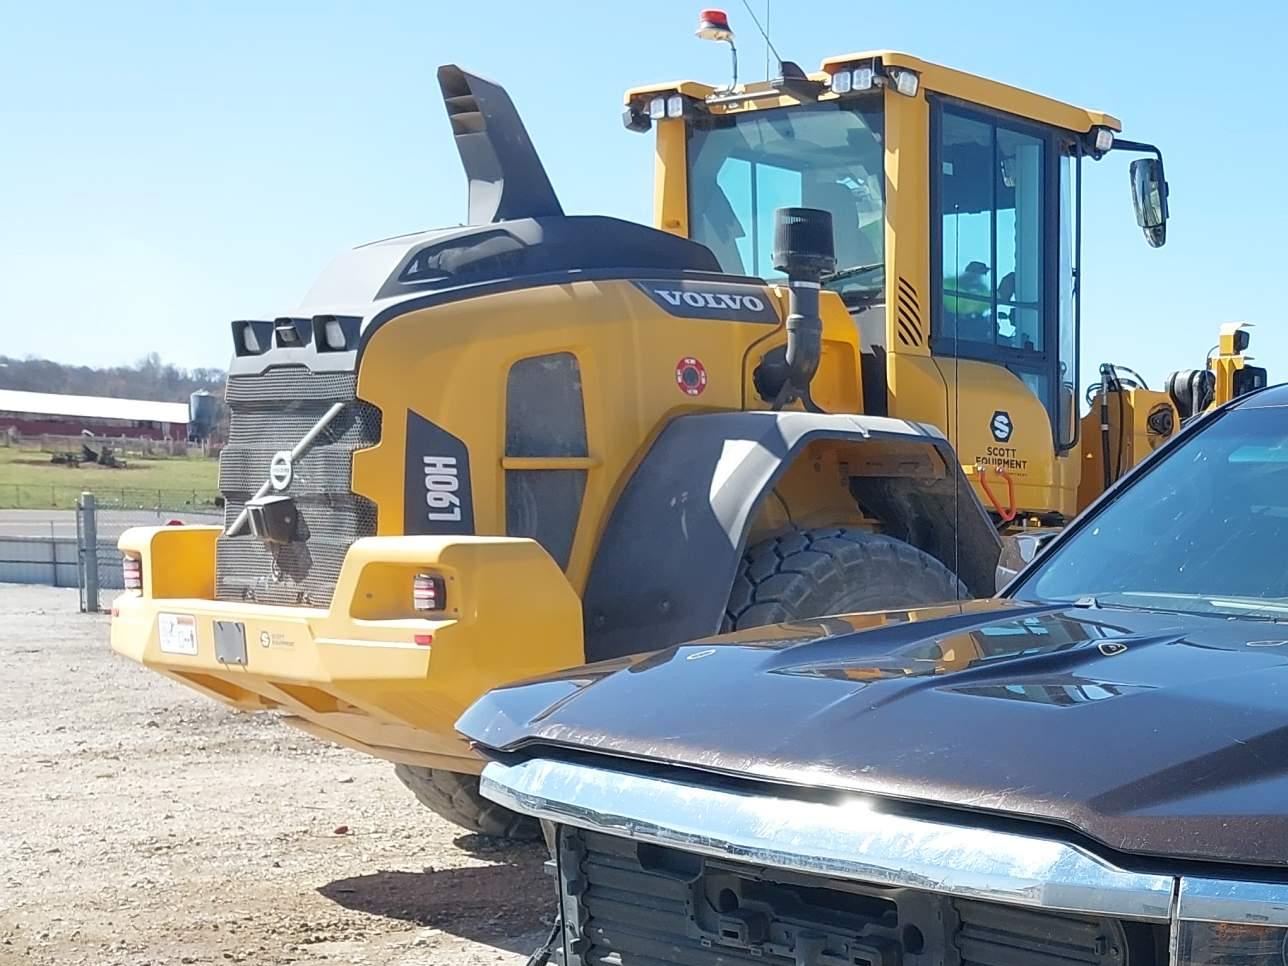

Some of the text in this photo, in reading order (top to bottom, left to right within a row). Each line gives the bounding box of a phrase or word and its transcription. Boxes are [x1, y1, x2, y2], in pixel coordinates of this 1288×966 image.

[654, 289, 764, 312] VOLVO
[987, 447, 1017, 458] SCOTT
[975, 456, 1027, 469] EQUIPMENT
[423, 456, 462, 521] L90H
